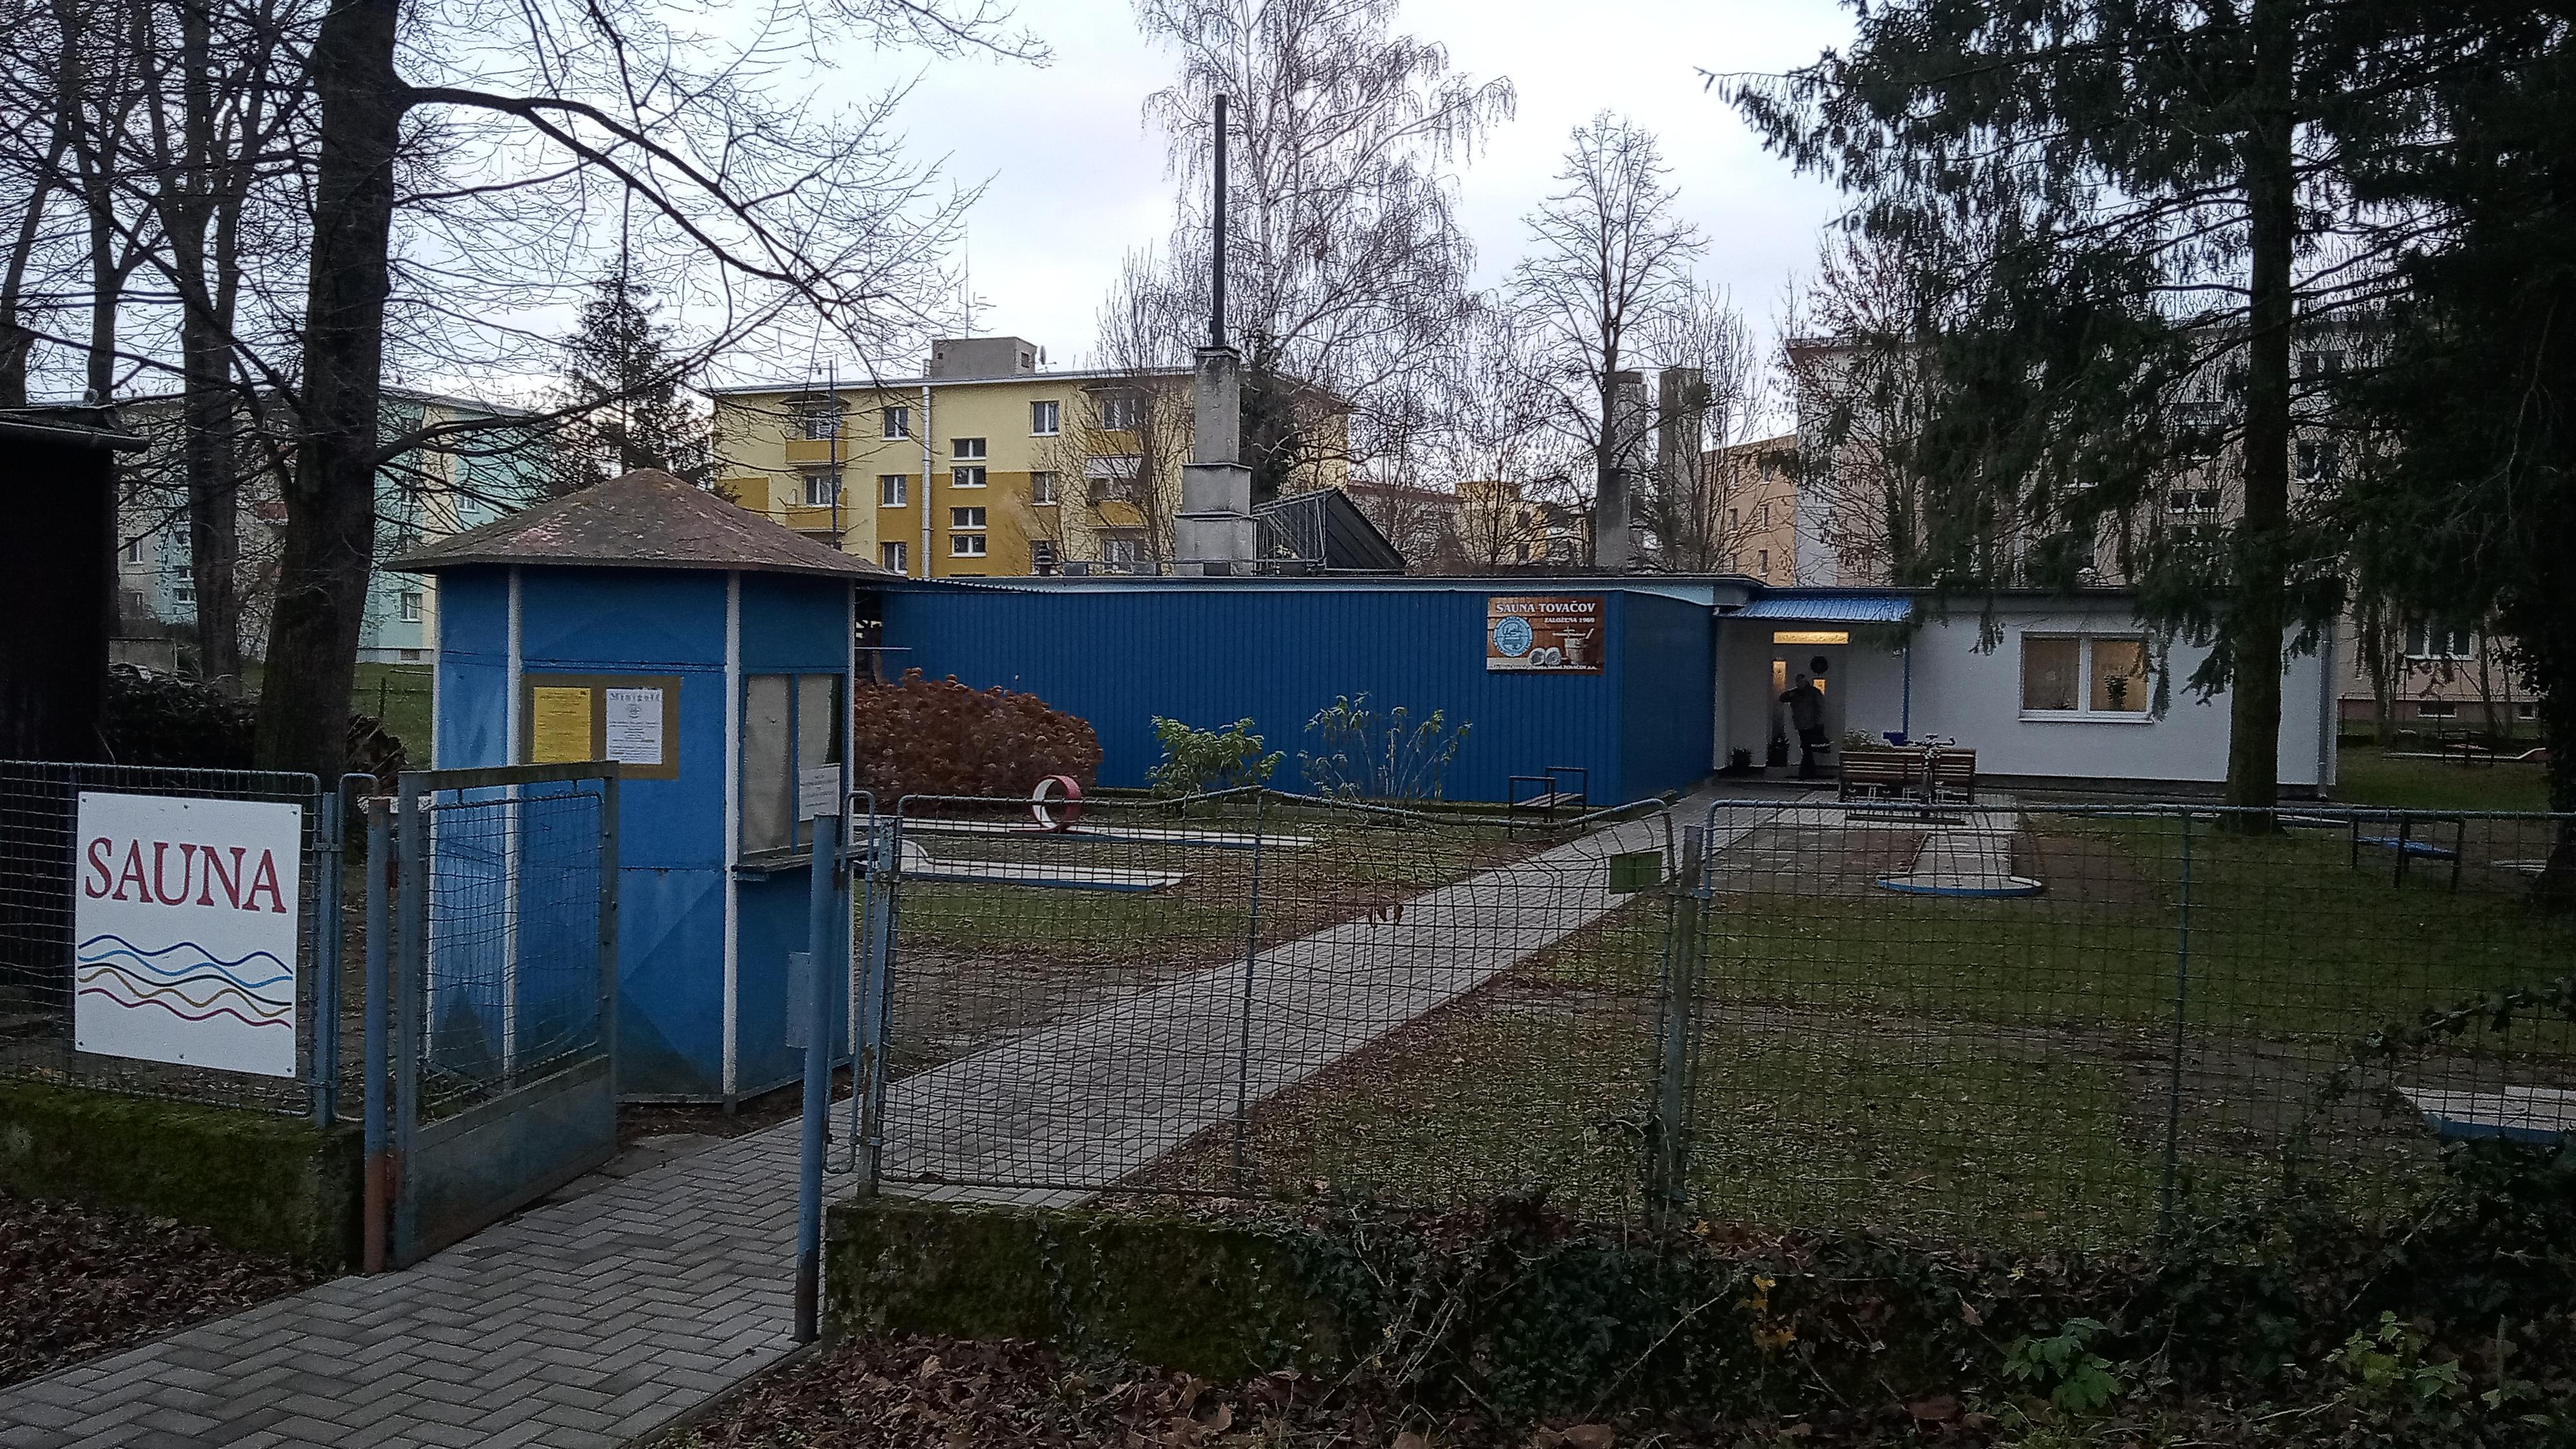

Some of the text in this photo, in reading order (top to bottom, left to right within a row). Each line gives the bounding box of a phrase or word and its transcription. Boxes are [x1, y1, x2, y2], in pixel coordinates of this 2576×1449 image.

[1496, 600, 1596, 612] SAUNA TOVAČOV
[85, 837, 287, 914] SAUNA
